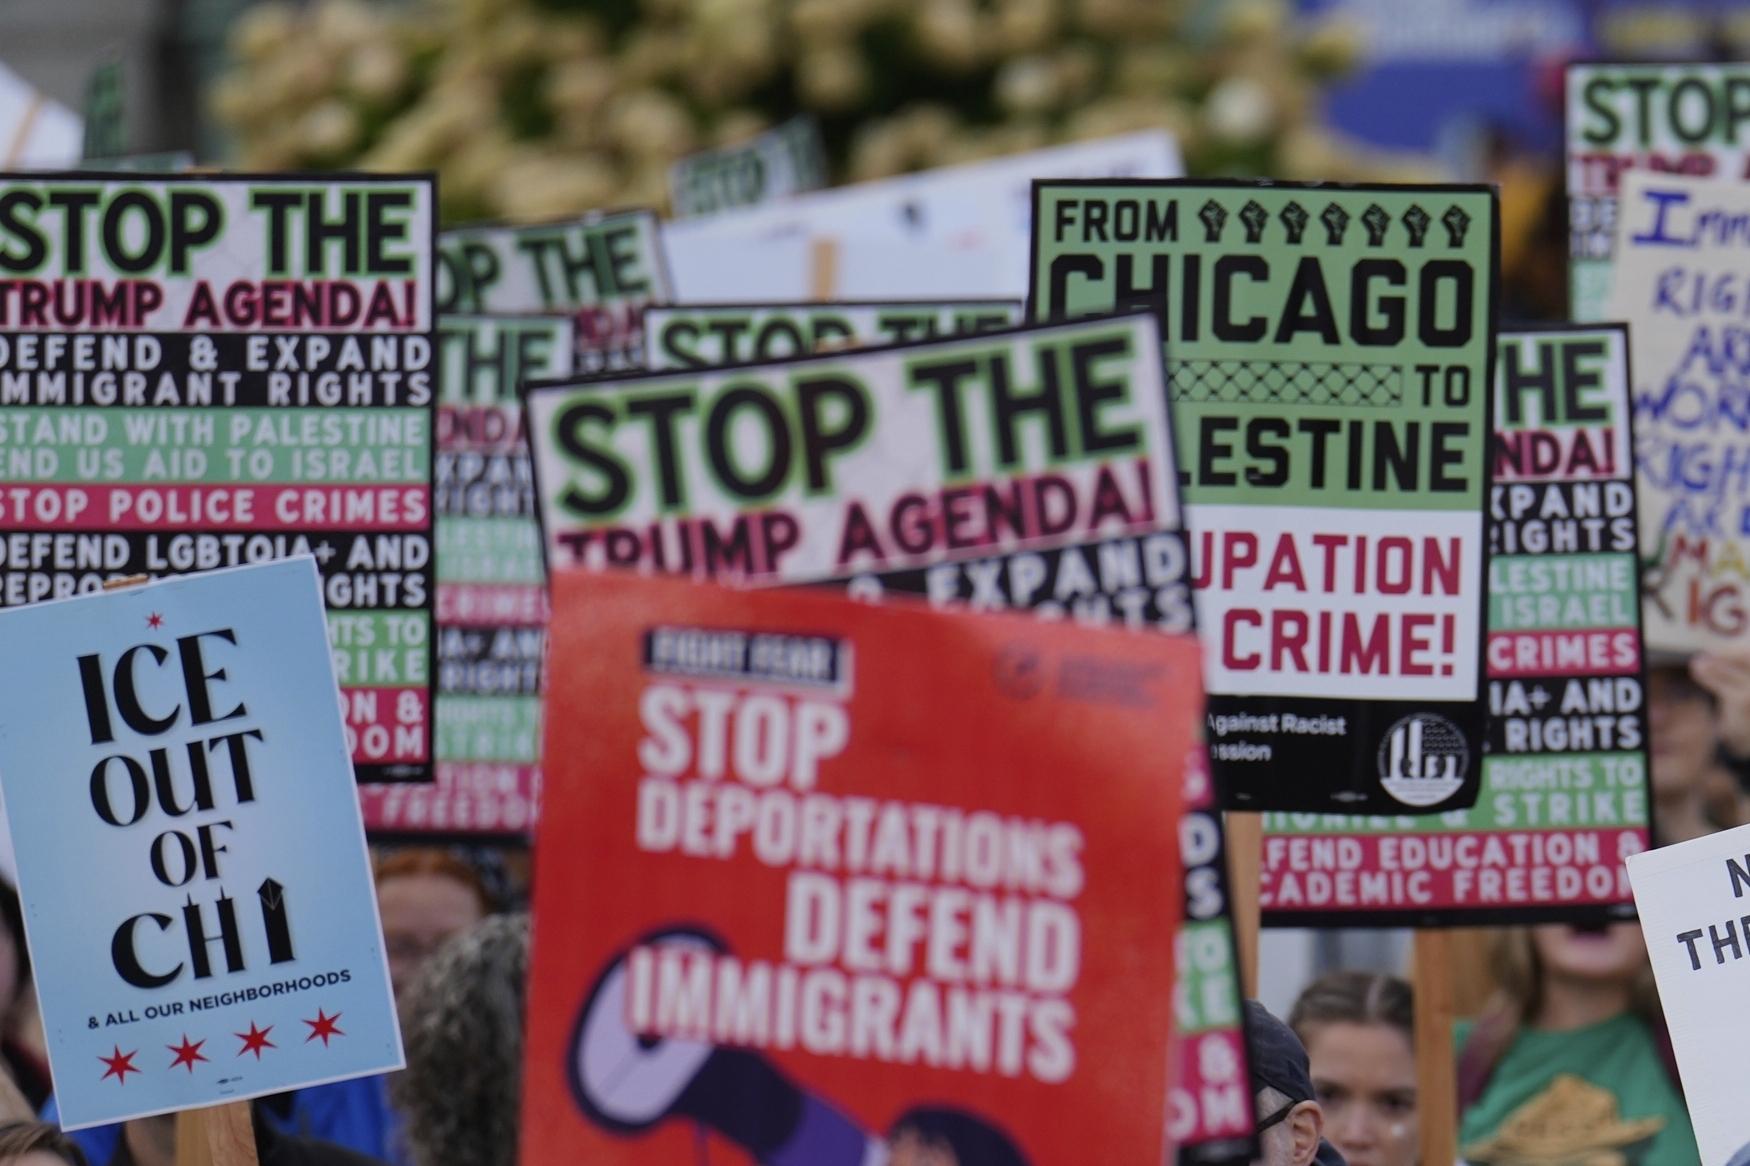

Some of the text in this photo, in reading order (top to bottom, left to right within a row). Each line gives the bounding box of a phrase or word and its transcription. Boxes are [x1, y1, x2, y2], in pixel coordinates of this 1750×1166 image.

[0, 187, 416, 276] STOP THE
[1054, 198, 1180, 243] FROM
[518, 222, 652, 303] THE
[0, 279, 417, 328] TRUMP AGENDA!
[1049, 252, 1475, 348] CHICAGO
[188, 335, 219, 371] &
[246, 335, 432, 371] EXPAND
[268, 371, 432, 406] RIGHTS
[1414, 364, 1471, 407] TO
[124, 413, 214, 446] WITH
[230, 413, 424, 446] PALESTINE
[554, 368, 872, 518] STOP
[908, 332, 1146, 475] THE
[77, 447, 124, 480] US
[145, 447, 208, 480] AID
[225, 447, 275, 480] TO
[292, 447, 424, 480] ISRAEL
[1180, 415, 1470, 493] ESTINE
[0, 489, 427, 524] TOP POLICE CRIMES
[556, 458, 1155, 584] TRUMP AGENDA!
[0, 533, 131, 570] EFEND
[346, 533, 430, 569] AND
[926, 535, 1187, 607] EXPAND
[322, 574, 427, 608] GHTS
[1502, 593, 1630, 626] ISRAEL
[385, 617, 427, 647] TO
[1222, 607, 1456, 677] CRIME!
[1487, 629, 1637, 671] CRIMES
[76, 627, 249, 746] ICE
[397, 689, 425, 724] &
[1560, 678, 1642, 715] AND
[637, 685, 849, 792] STOP
[1281, 713, 1347, 736] Racist
[1505, 715, 1641, 752] RIGHTS
[90, 728, 264, 827] OUT
[1488, 757, 1645, 790] RIGHTS TO
[1493, 790, 1648, 828] STRIKE
[150, 820, 235, 887] OF
[636, 777, 1085, 900] DEPORTATIONS
[1262, 827, 1645, 872] FEND EDUCATION &
[110, 876, 297, 990] CHI
[784, 869, 1081, 993] DEFEND
[87, 968, 353, 1030] & ALL OUR NEIGHBORHOODS
[627, 945, 1076, 1084] IMMIGRANTS
